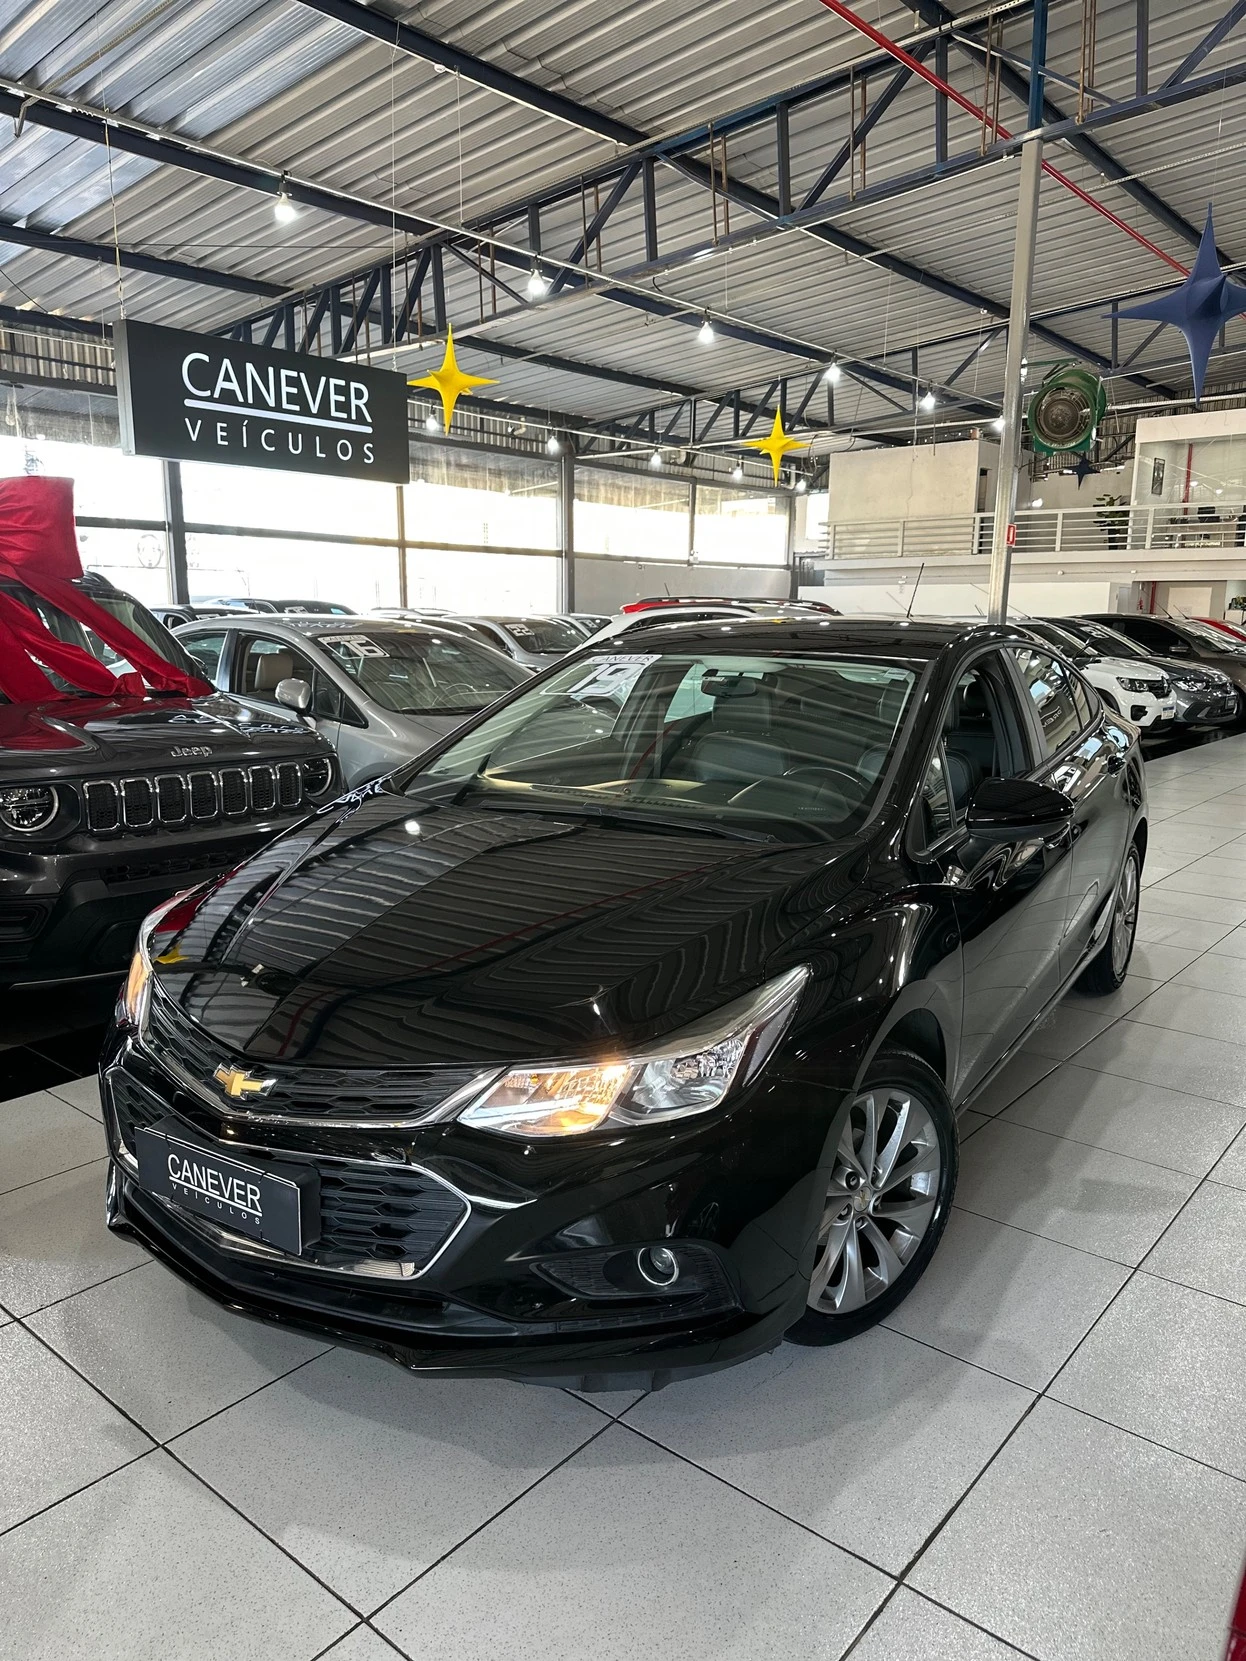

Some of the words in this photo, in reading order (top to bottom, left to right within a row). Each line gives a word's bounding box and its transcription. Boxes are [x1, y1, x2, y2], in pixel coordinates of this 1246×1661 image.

[181, 352, 373, 423] CANEVER
[184, 417, 375, 464] VEÍCULOS
[340, 640, 386, 657] 16
[566, 663, 643, 694] 19
[170, 745, 213, 757] Jeep
[167, 1153, 263, 1213] CANEVER
